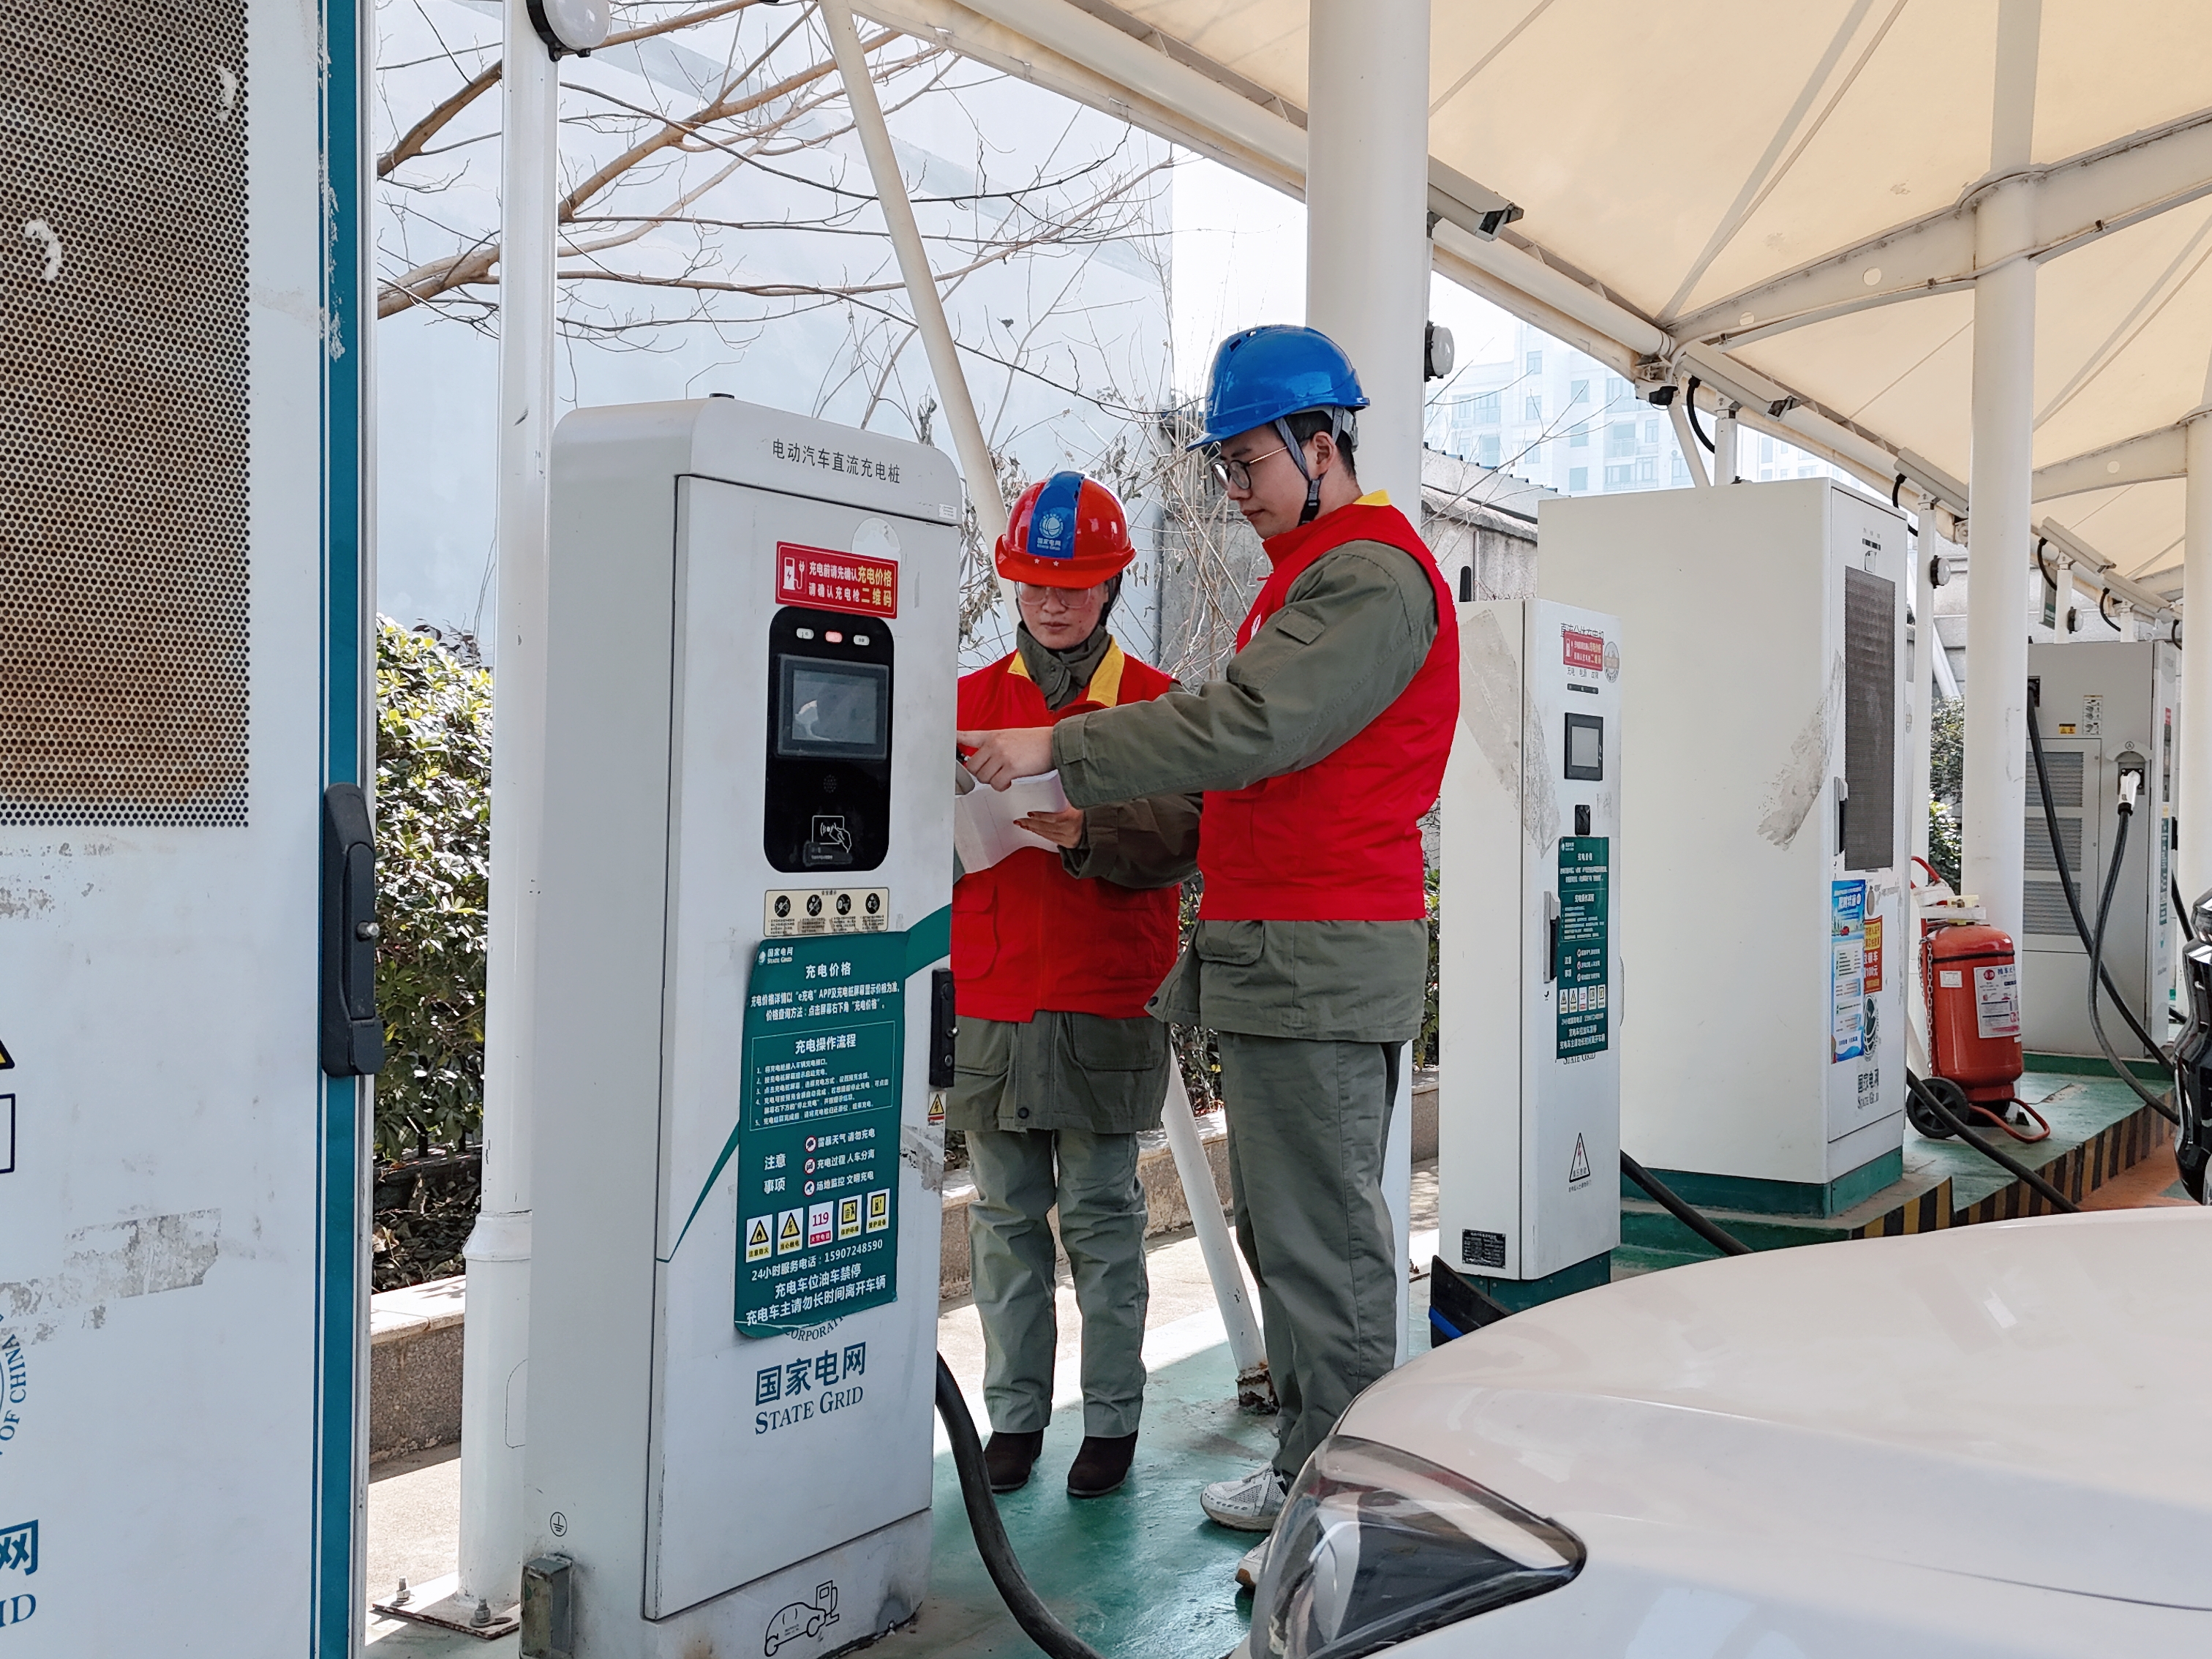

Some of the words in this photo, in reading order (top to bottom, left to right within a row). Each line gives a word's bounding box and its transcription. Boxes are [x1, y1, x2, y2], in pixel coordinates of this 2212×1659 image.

[772, 438, 900, 484] 电动汽车直流充电桩
[809, 562, 892, 588] 充电前请先确认充电价格
[805, 962, 851, 979] 充电价格
[795, 1034, 856, 1054] 充电操作流程
[848, 1128, 876, 1142] 请勿充电
[764, 1153, 786, 1170] 注意
[817, 1154, 846, 1169] 充电过程
[764, 1177, 786, 1194] 事项
[846, 1171, 874, 1185] 文明充电
[812, 1212, 829, 1227] 119
[775, 1263, 862, 1299] 充电车位油车禁停
[746, 1275, 887, 1326] 充电车主请勿长时间离开车辆
[786, 1317, 843, 1342] ORPORAT
[2, 1334, 26, 1403] CHINA
[756, 1342, 866, 1406] 国家电网
[756, 1401, 814, 1435] STATE
[819, 1386, 864, 1414] GRID
